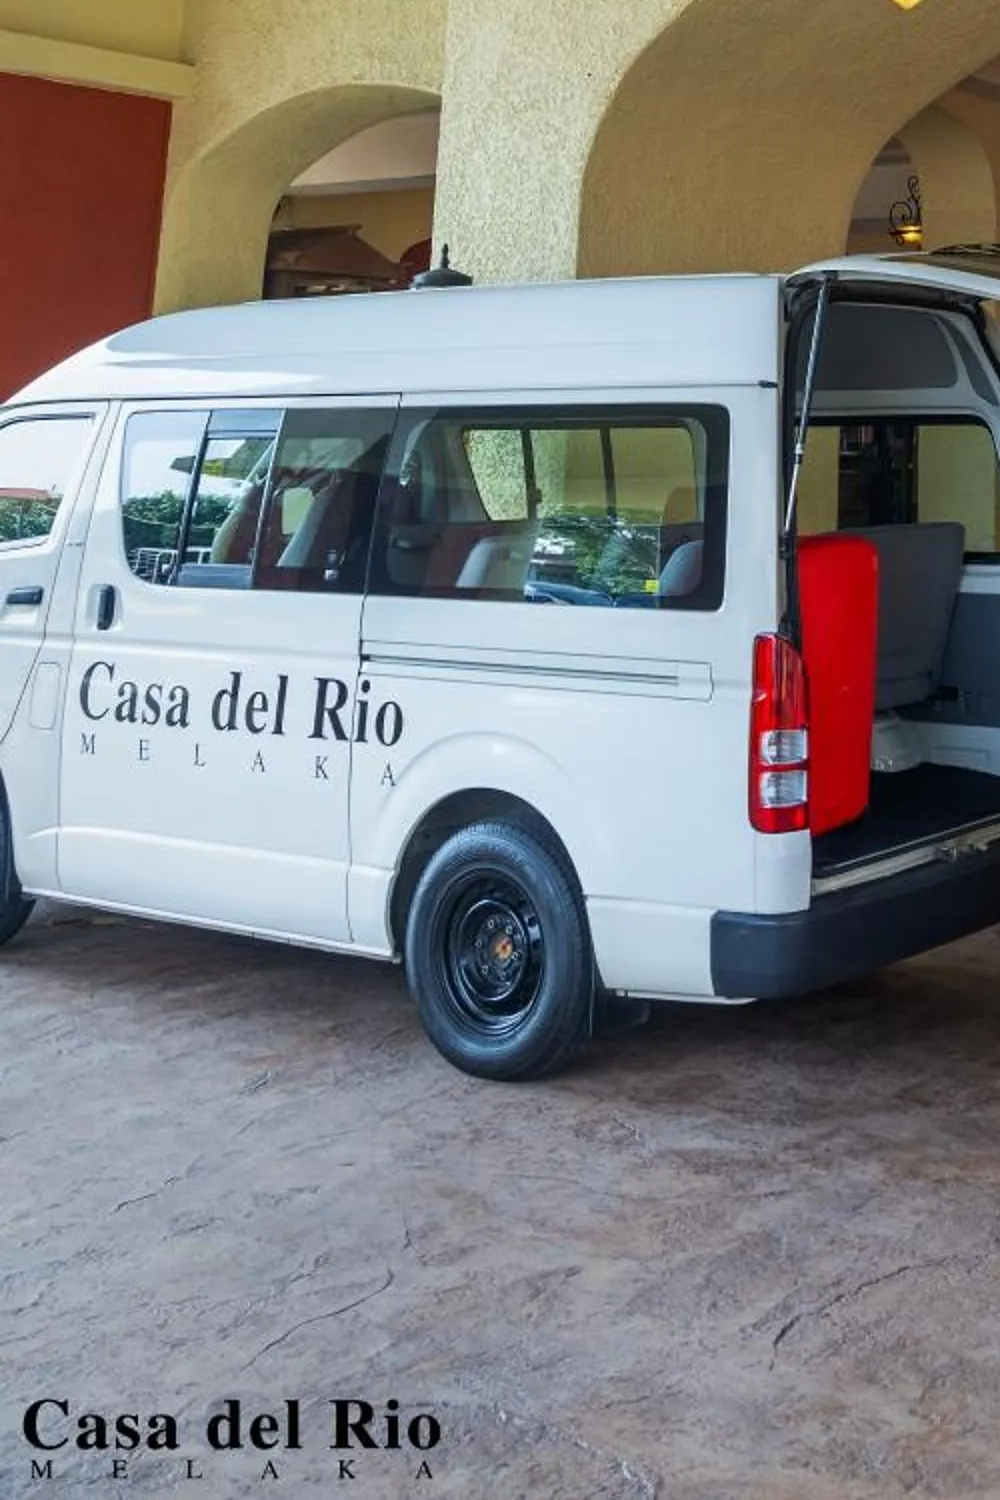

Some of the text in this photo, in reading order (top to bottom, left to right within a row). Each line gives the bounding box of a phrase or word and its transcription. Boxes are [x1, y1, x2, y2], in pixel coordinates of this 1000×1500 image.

[79, 661, 403, 746] Casa del Rio
